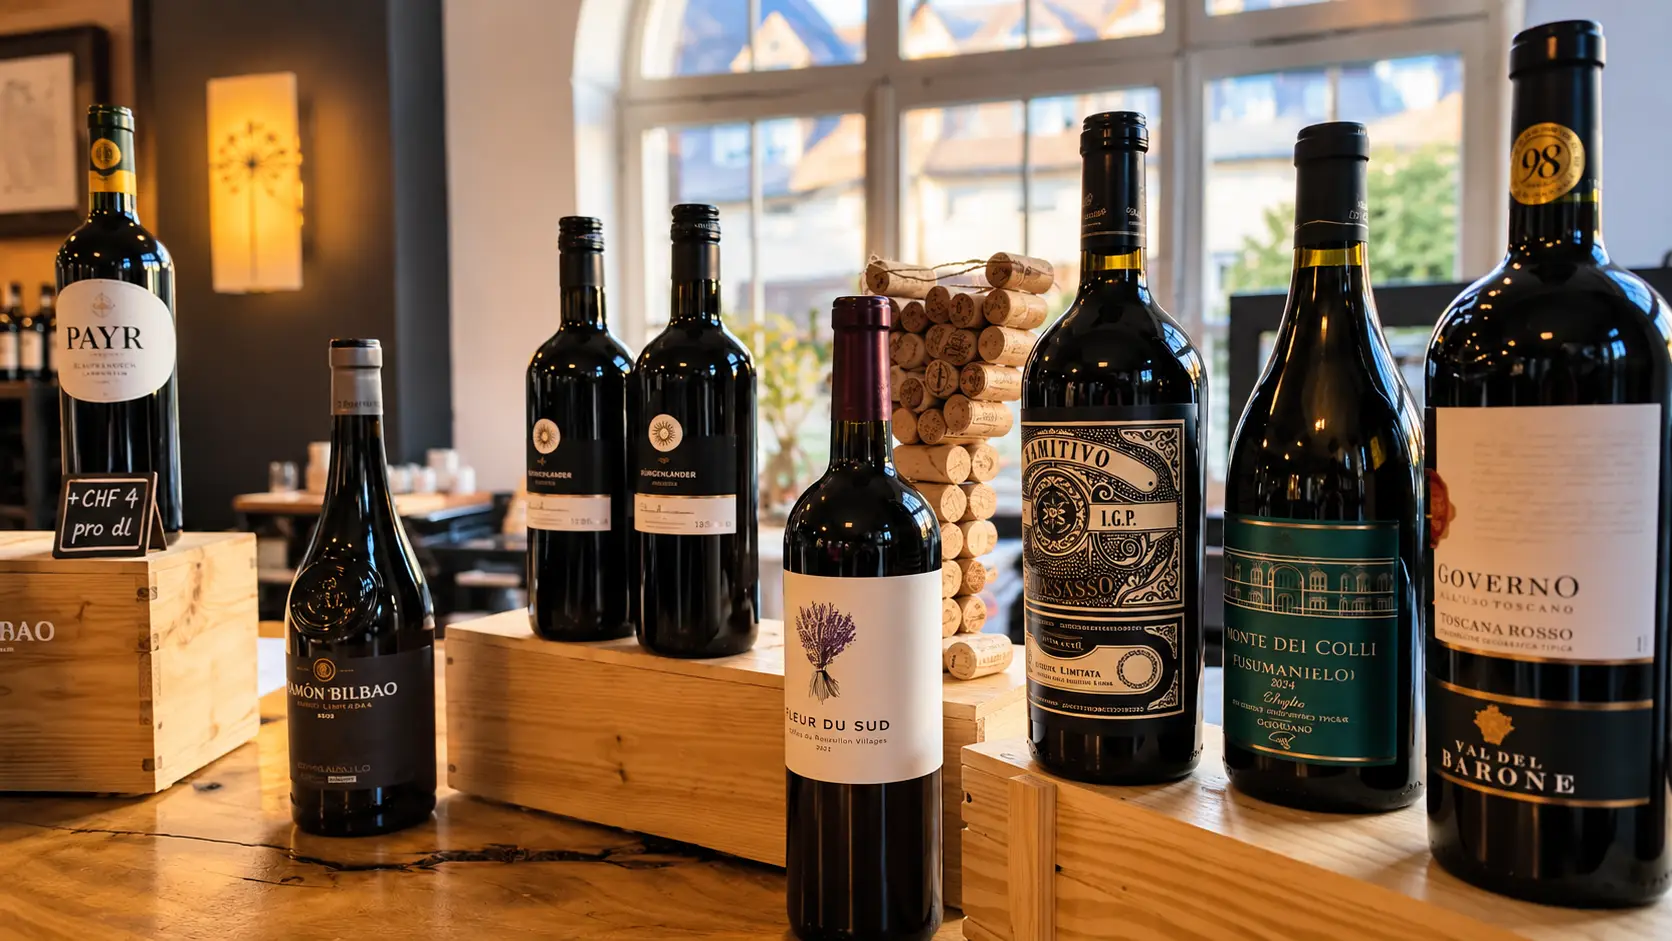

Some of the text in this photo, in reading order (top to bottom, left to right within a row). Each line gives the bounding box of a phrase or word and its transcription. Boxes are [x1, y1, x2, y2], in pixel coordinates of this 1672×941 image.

[1521, 144, 1561, 184] 98
[66, 326, 144, 349] PAYR
[125, 488, 139, 509] 4
[71, 517, 132, 545] pro dl
[1101, 510, 1137, 527] I.G.P.
[1438, 563, 1579, 599] GOVERNO
[1440, 612, 1504, 636] TOSCANA
[1508, 624, 1573, 642] ROSSO
[1274, 636, 1306, 654] DEI
[1315, 639, 1376, 656] COLLI
[823, 719, 846, 731] DU
[854, 720, 890, 732] SUD
[1455, 740, 1542, 769] VAL DEL
[1442, 748, 1575, 794] BARONE
